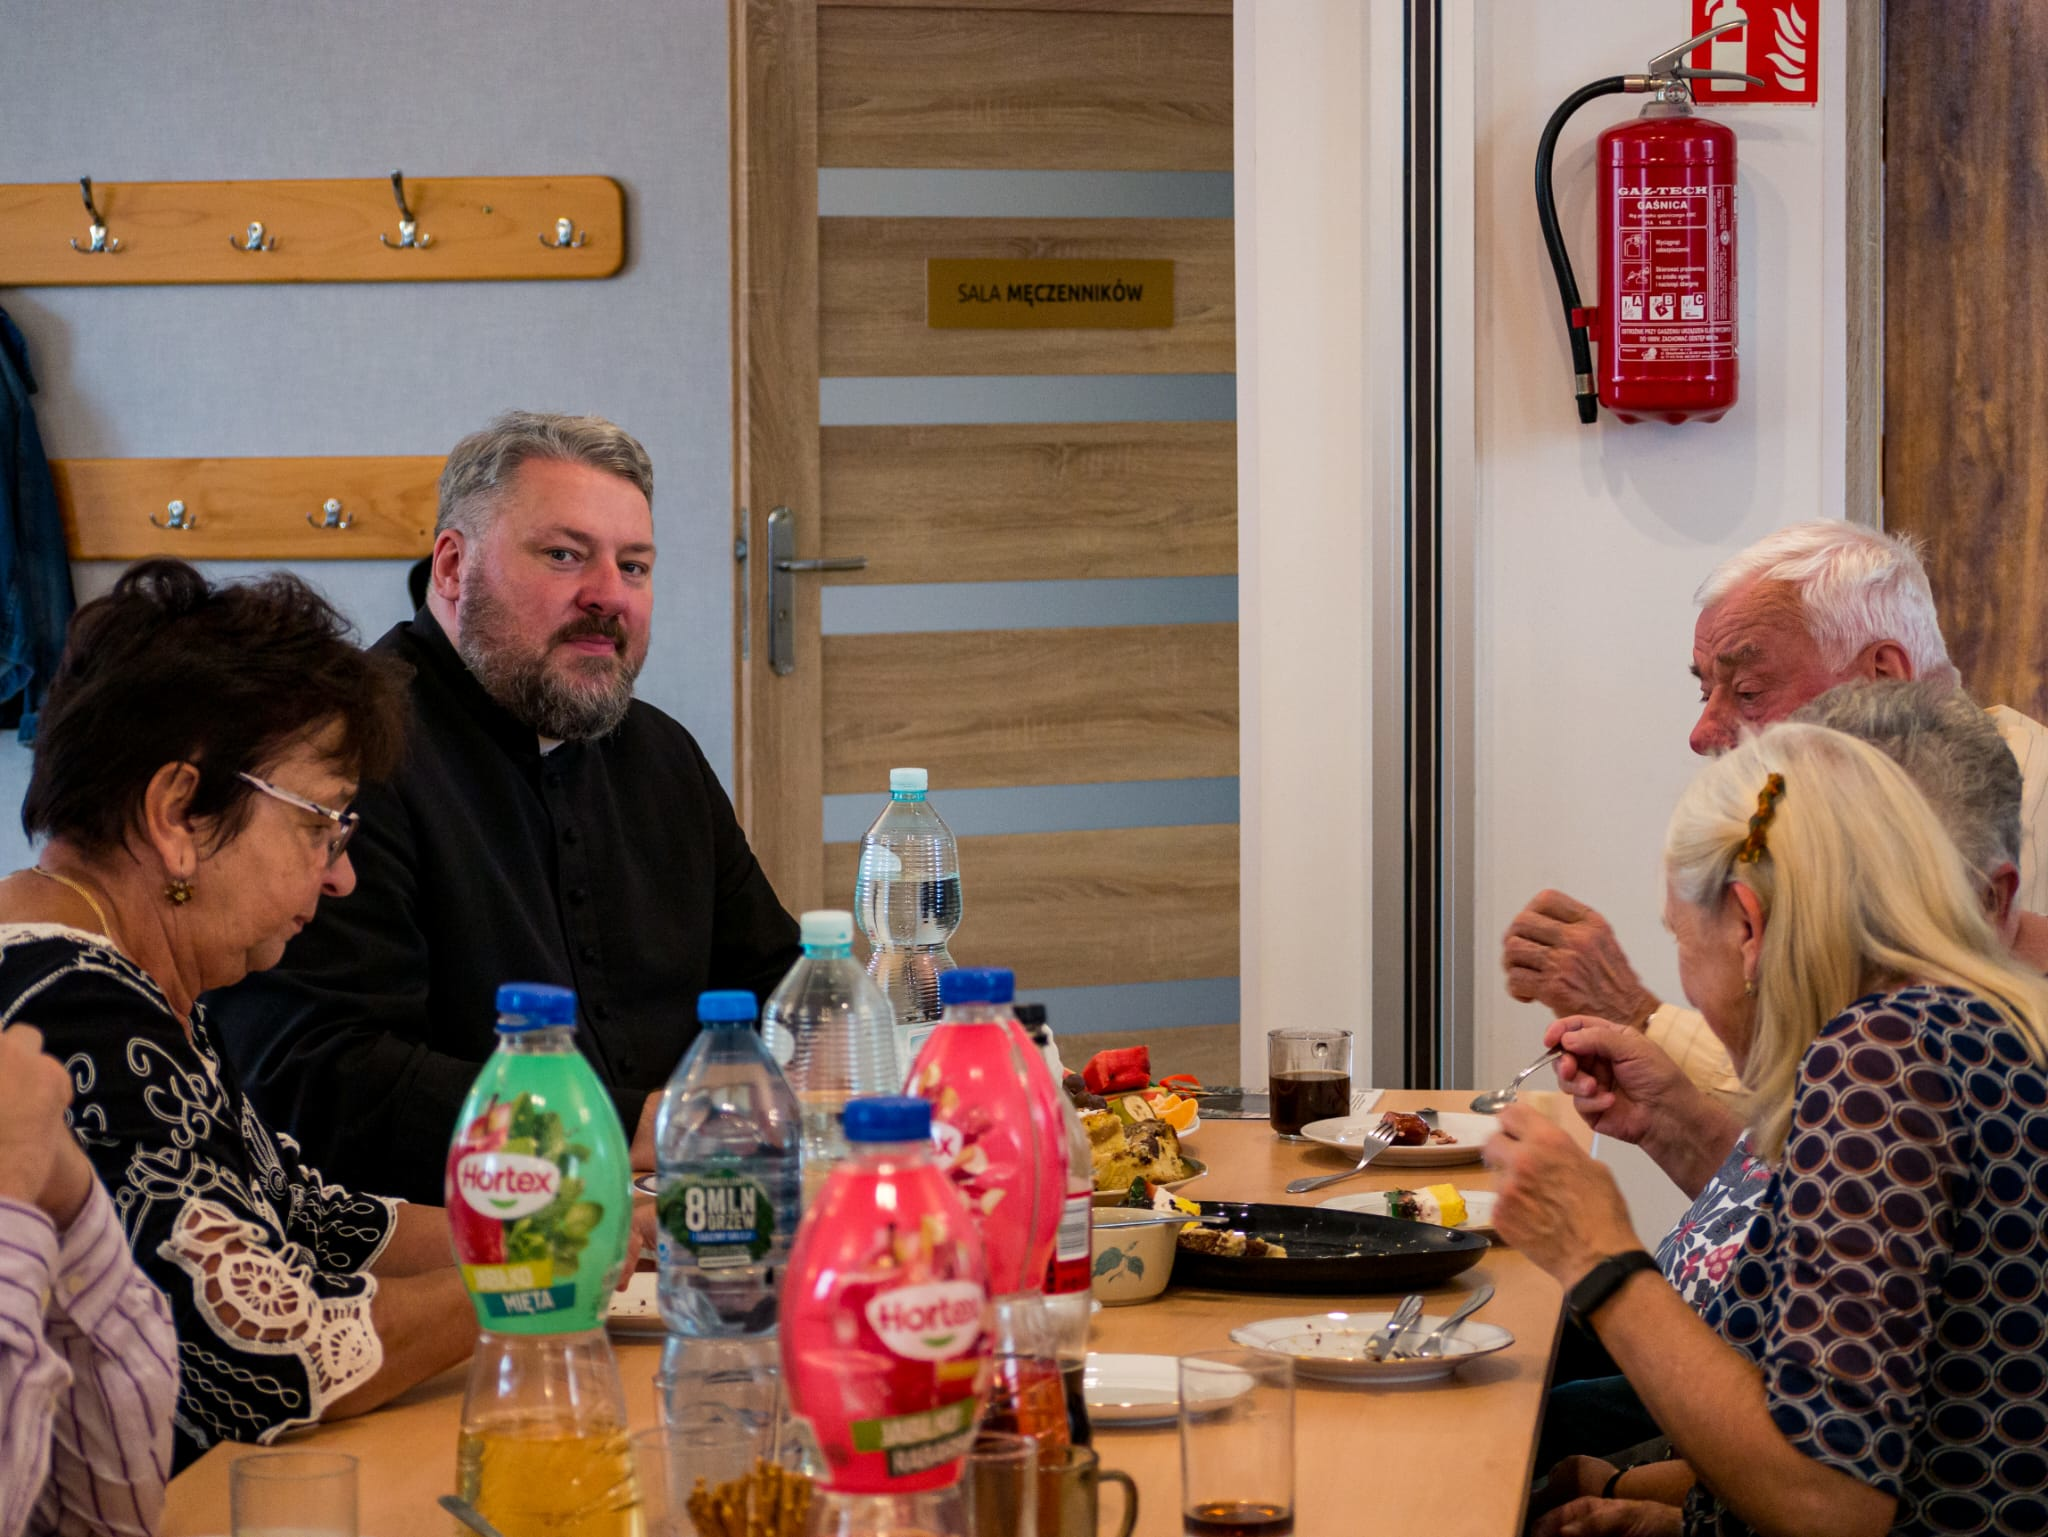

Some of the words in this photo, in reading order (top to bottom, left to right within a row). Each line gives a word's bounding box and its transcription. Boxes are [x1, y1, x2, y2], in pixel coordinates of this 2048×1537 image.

[1618, 186, 1708, 196] GAZ-TECH
[1637, 200, 1689, 210] GAŚNICA
[958, 283, 1000, 302] SALA
[1007, 278, 1143, 307] MĘCZENNIKÓW
[1634, 295, 1642, 305] A
[1665, 295, 1673, 305] B
[1695, 294, 1704, 305] C
[462, 1163, 553, 1194] Hortex
[685, 1187, 706, 1232] 8
[707, 1187, 757, 1214] MLN
[501, 1288, 556, 1315] MIĘTA
